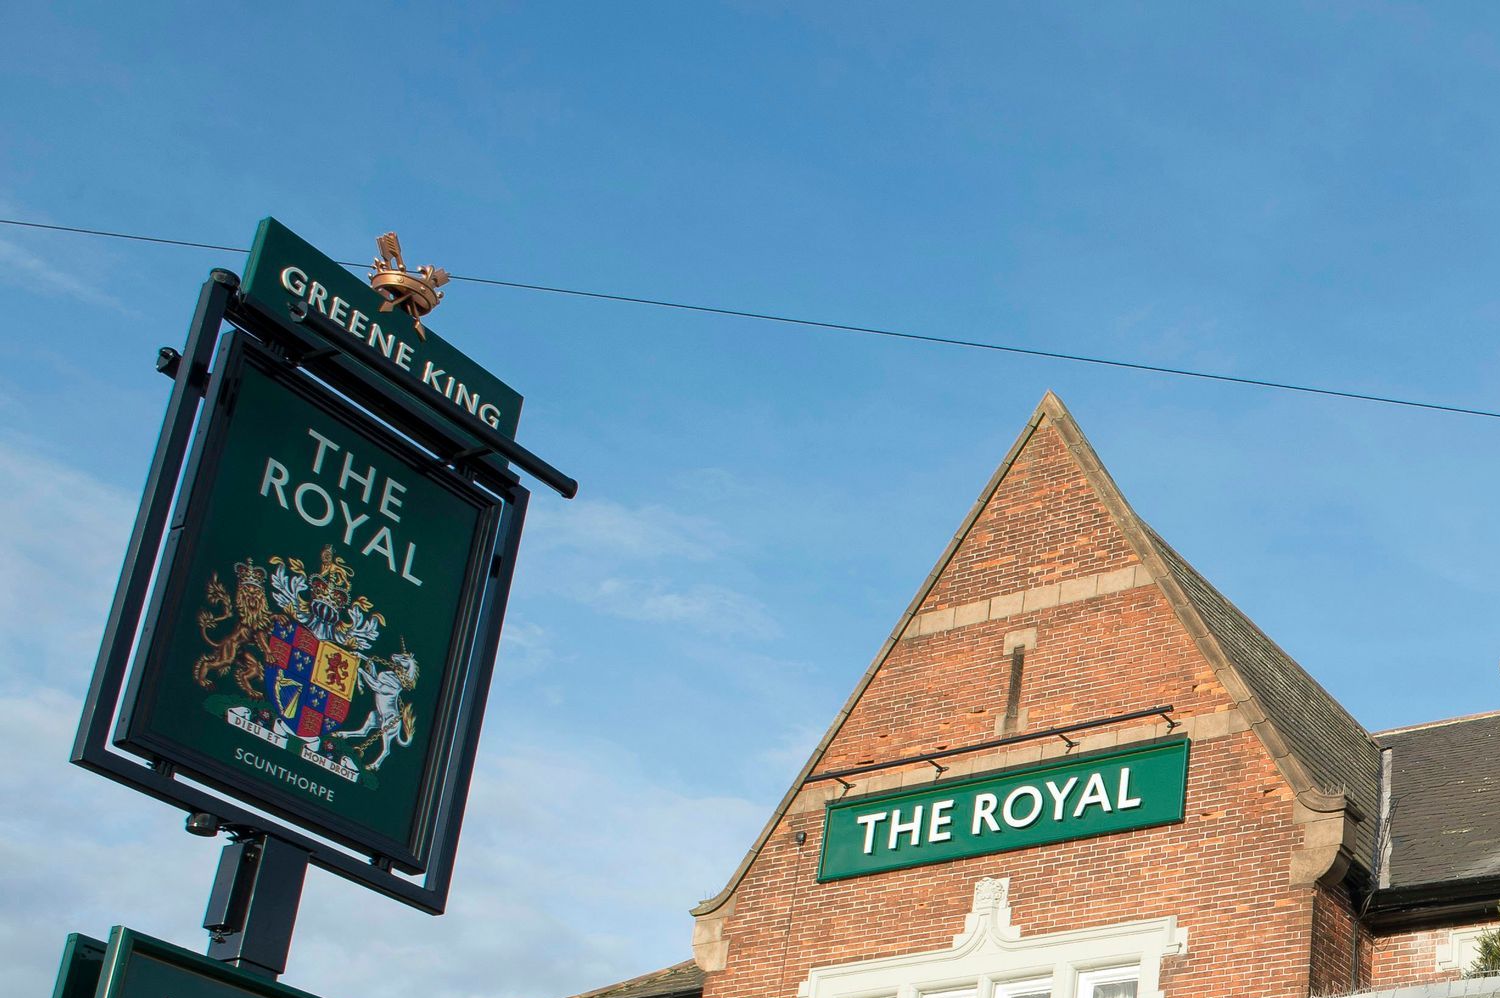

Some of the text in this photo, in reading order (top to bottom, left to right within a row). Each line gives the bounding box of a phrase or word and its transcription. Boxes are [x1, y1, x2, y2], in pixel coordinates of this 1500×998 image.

[281, 266, 501, 429] GREENE KING
[308, 428, 407, 523] THE
[260, 457, 424, 587] ROYAL
[235, 717, 280, 744] DIEU ET
[303, 749, 356, 781] MON DROIT
[235, 748, 335, 802] SCUNTHORPE
[857, 767, 1142, 854] THE ROYAL
